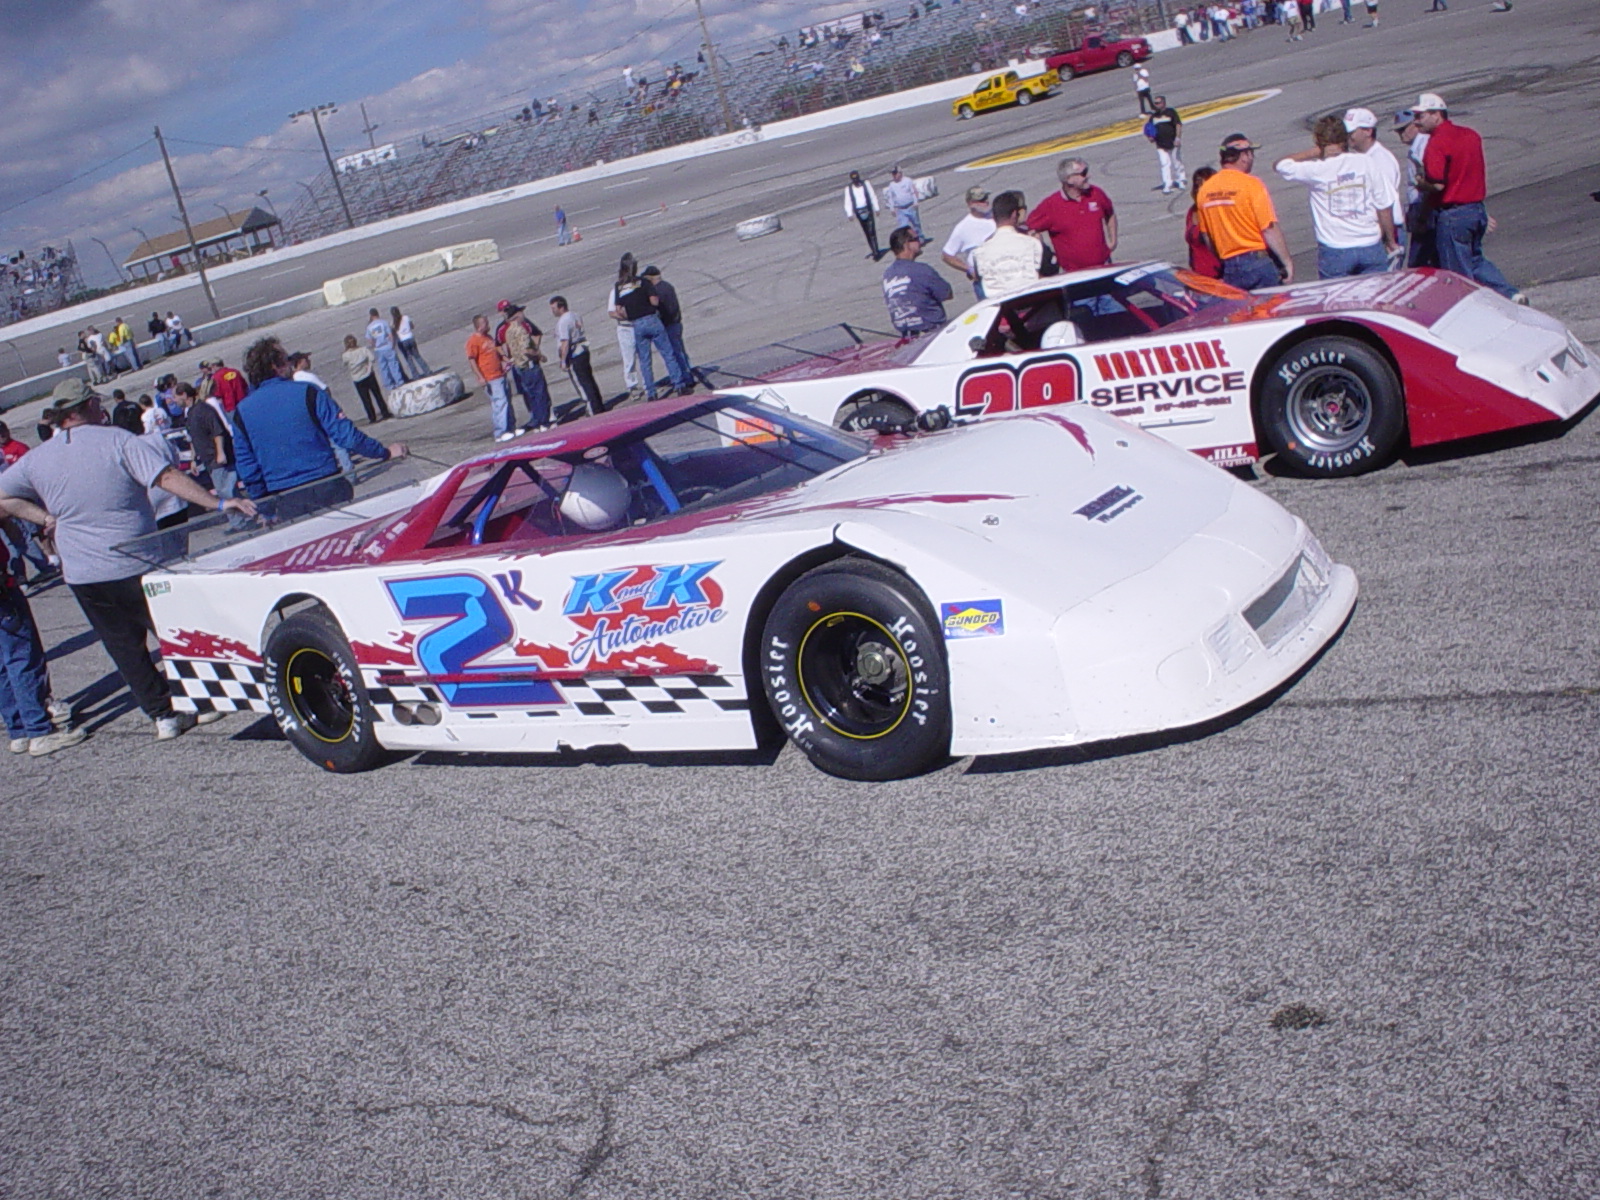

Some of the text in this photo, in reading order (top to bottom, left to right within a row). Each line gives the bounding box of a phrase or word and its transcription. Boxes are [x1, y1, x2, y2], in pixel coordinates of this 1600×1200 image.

[1090, 371, 1247, 408] SERVICE
[1093, 339, 1231, 382] NORTHSIDE
[1278, 348, 1347, 386] Hoosier
[563, 569, 635, 616] K
[644, 558, 726, 609] K
[380, 570, 573, 711] 2
[571, 605, 729, 665] Automotive
[947, 612, 998, 626] SUNOCO
[764, 635, 815, 738] Hoosier
[887, 615, 940, 726] Hoosier
